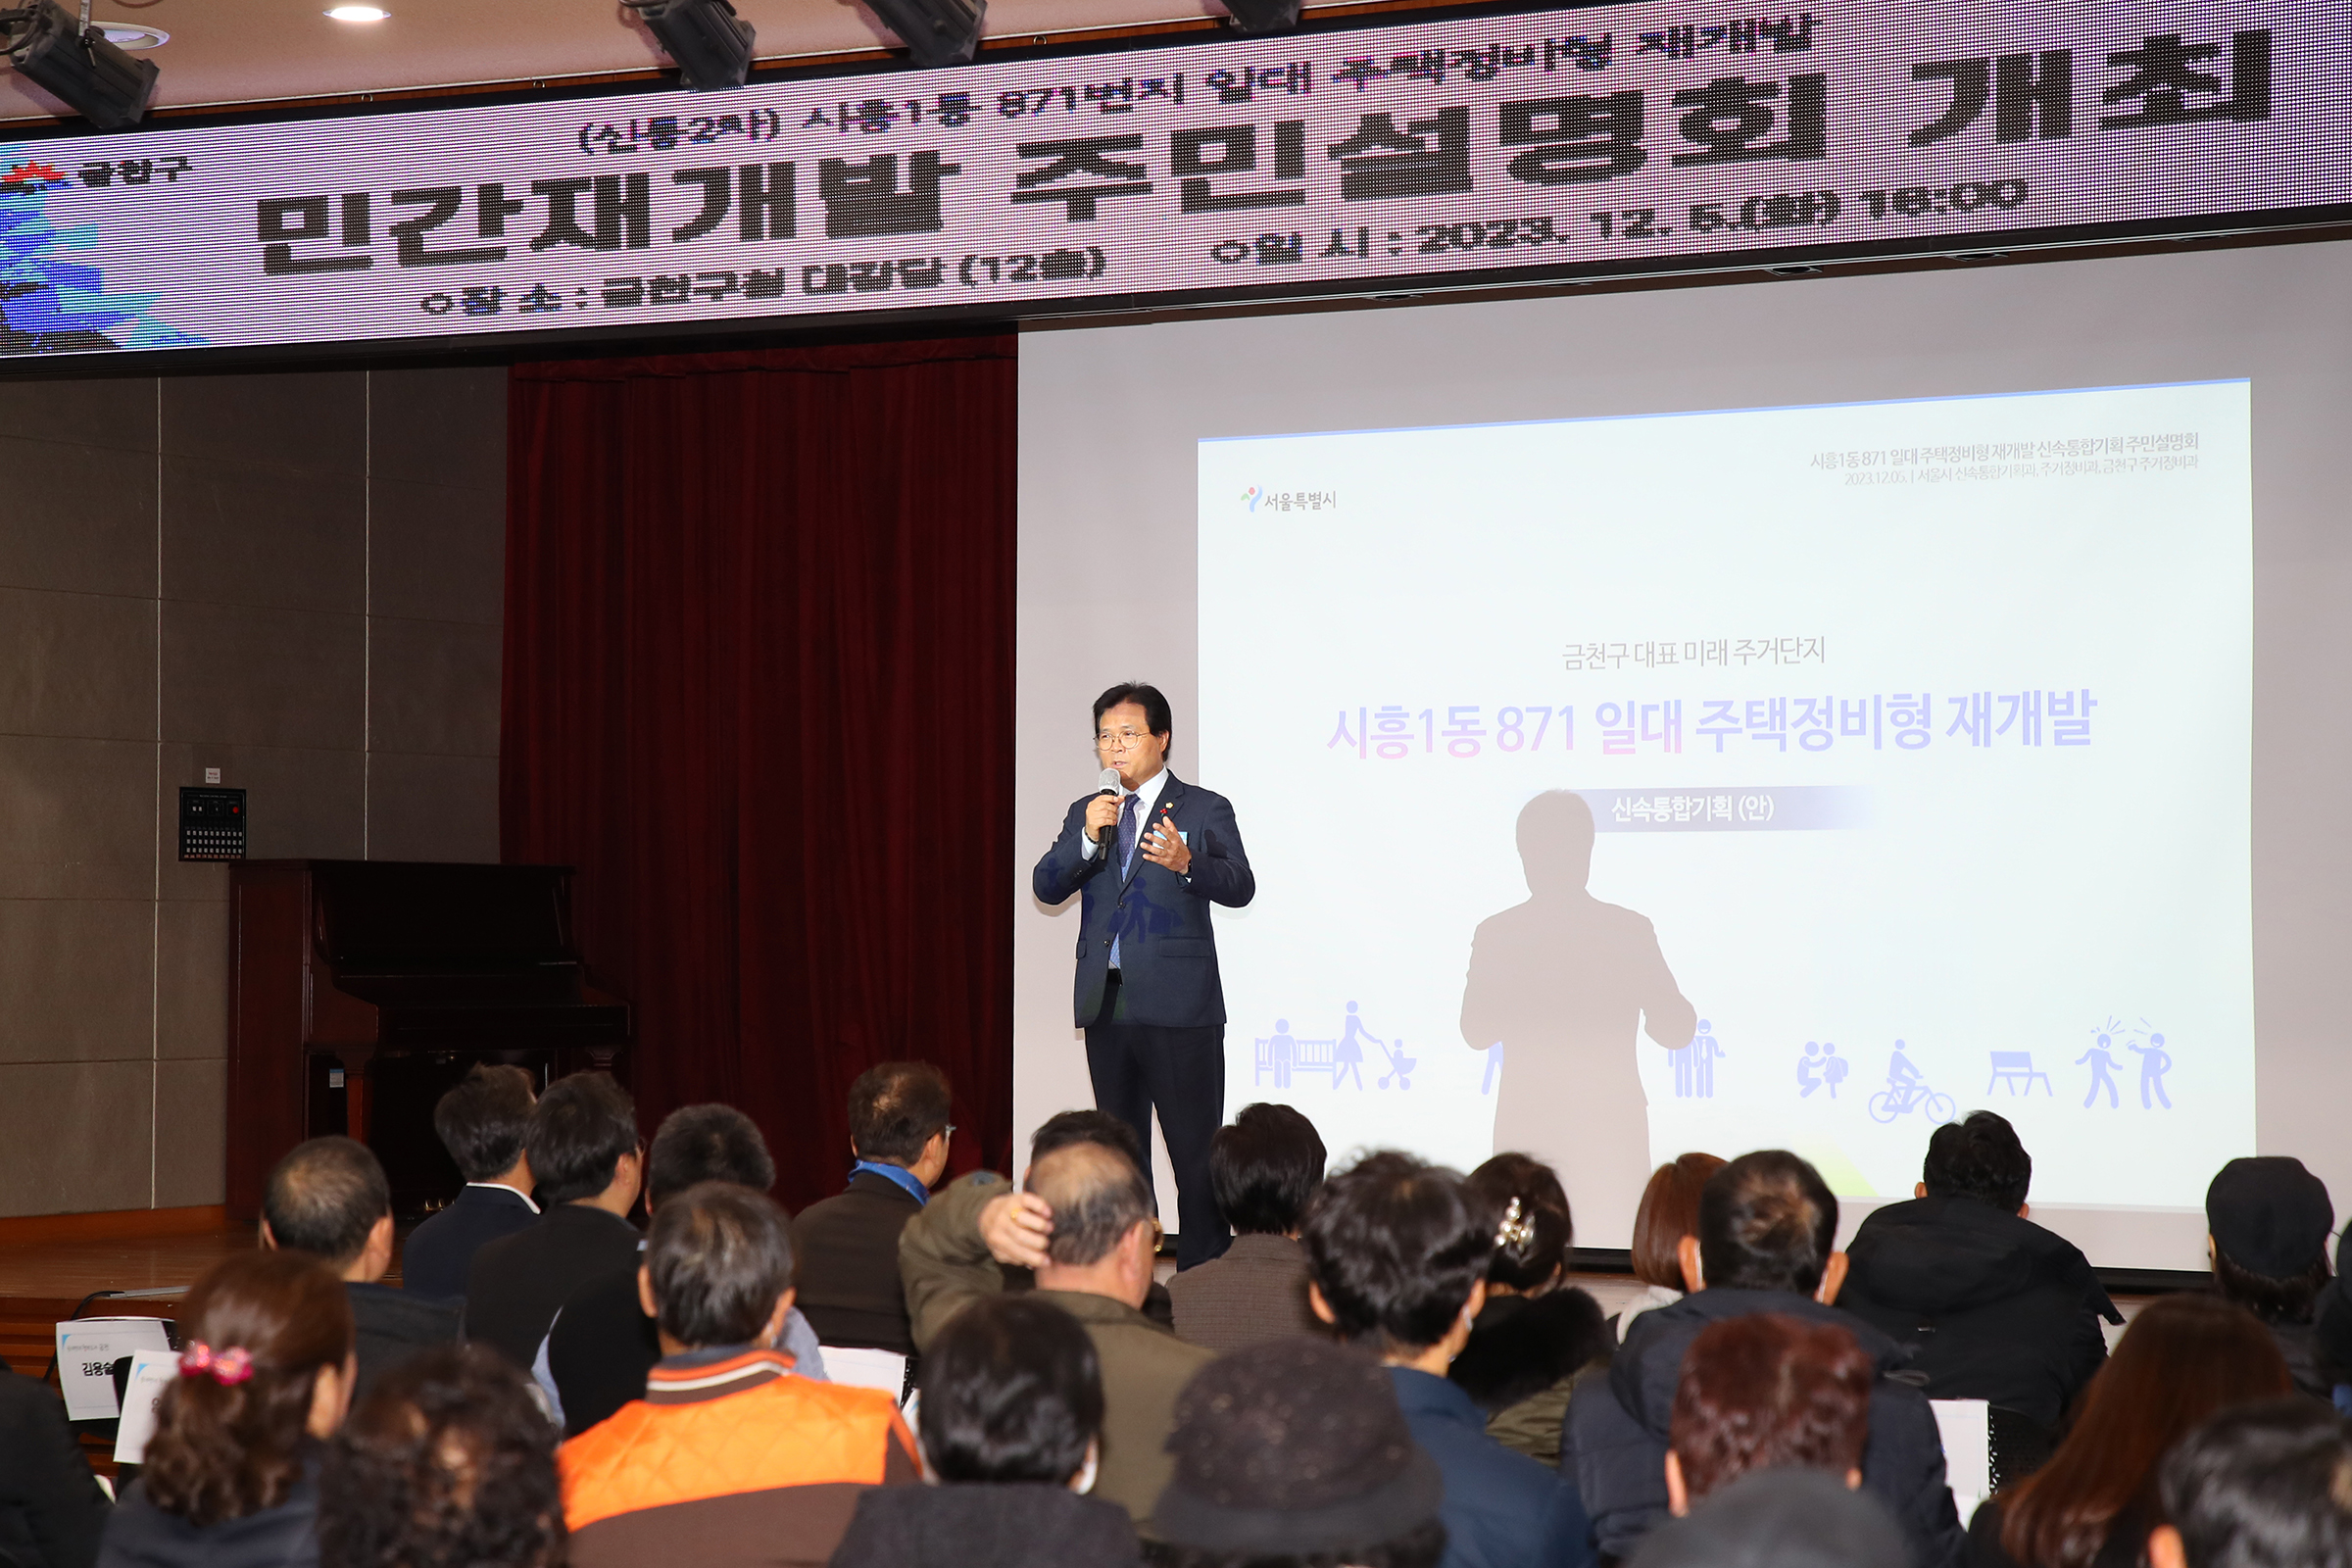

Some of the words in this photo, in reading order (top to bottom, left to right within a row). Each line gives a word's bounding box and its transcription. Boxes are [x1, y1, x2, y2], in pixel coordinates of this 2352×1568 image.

[998, 72, 1186, 119] 871번지
[1206, 61, 1313, 104] 일대
[1332, 32, 1613, 92] 주택정비형
[1637, 13, 1823, 58] 재개발
[257, 149, 962, 276] 민간재개발
[1011, 72, 1827, 223] 주민설명회
[1907, 27, 2272, 148] 개최
[1810, 451, 1861, 470] 시흥1동
[1862, 451, 1886, 466] 871
[1889, 448, 1918, 466] 일대
[1920, 443, 1990, 465] 주택정비형
[1992, 441, 2035, 461] 재개발
[2036, 436, 2125, 459] 신속통합기획
[2126, 432, 2200, 454] 주민설명회
[1918, 466, 1953, 483] 서울시
[2102, 457, 2139, 474] 금천구
[1264, 490, 1337, 513] 서울특별시
[1562, 642, 1631, 671] 금천구
[1633, 640, 1680, 668] 대표
[1684, 638, 1729, 667] 미래
[1733, 635, 1826, 666] 주거단지
[1327, 703, 1489, 760] 시흥1동
[1495, 705, 1576, 753] 871
[1592, 699, 1684, 756] 일대
[1695, 691, 1935, 753] 주택정비형
[1946, 688, 2099, 751] 재개발
[1611, 795, 1733, 822] 신속통합기획
[1738, 794, 1775, 821] (안)
